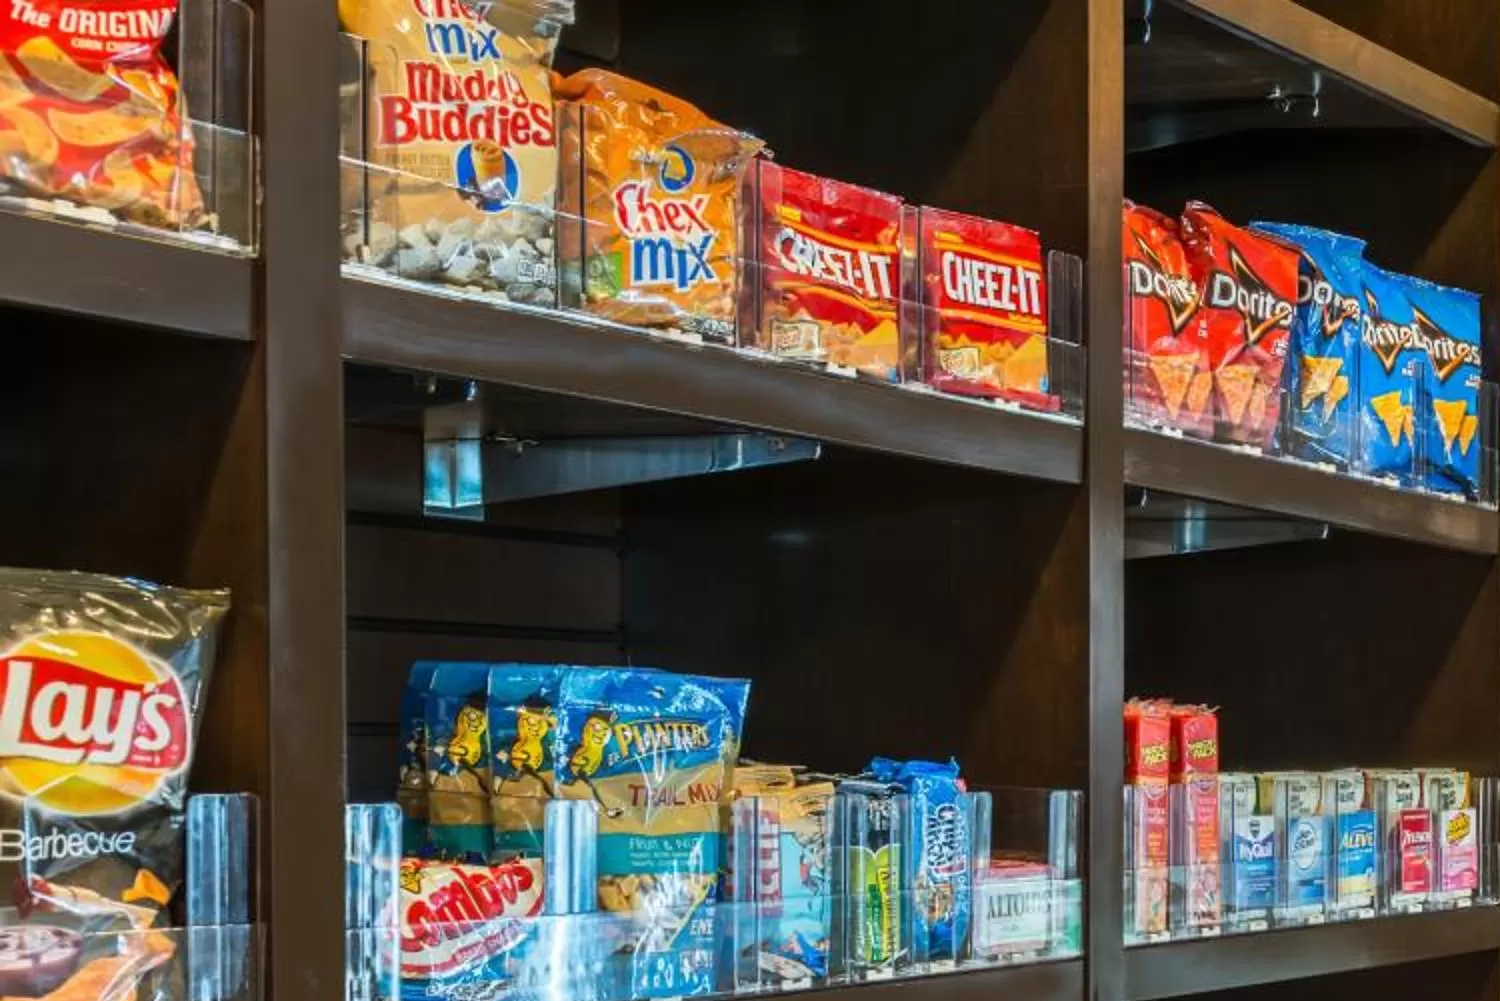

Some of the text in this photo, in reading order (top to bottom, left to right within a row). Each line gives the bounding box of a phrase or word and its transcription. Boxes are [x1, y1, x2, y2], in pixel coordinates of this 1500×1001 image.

[11, 0, 51, 28] The
[614, 182, 713, 235] Chex
[941, 249, 1041, 316] CHEEZ-IT
[1211, 272, 1296, 327] Dorito
[0, 658, 178, 769] Lay's
[0, 827, 137, 864] Barbecue
